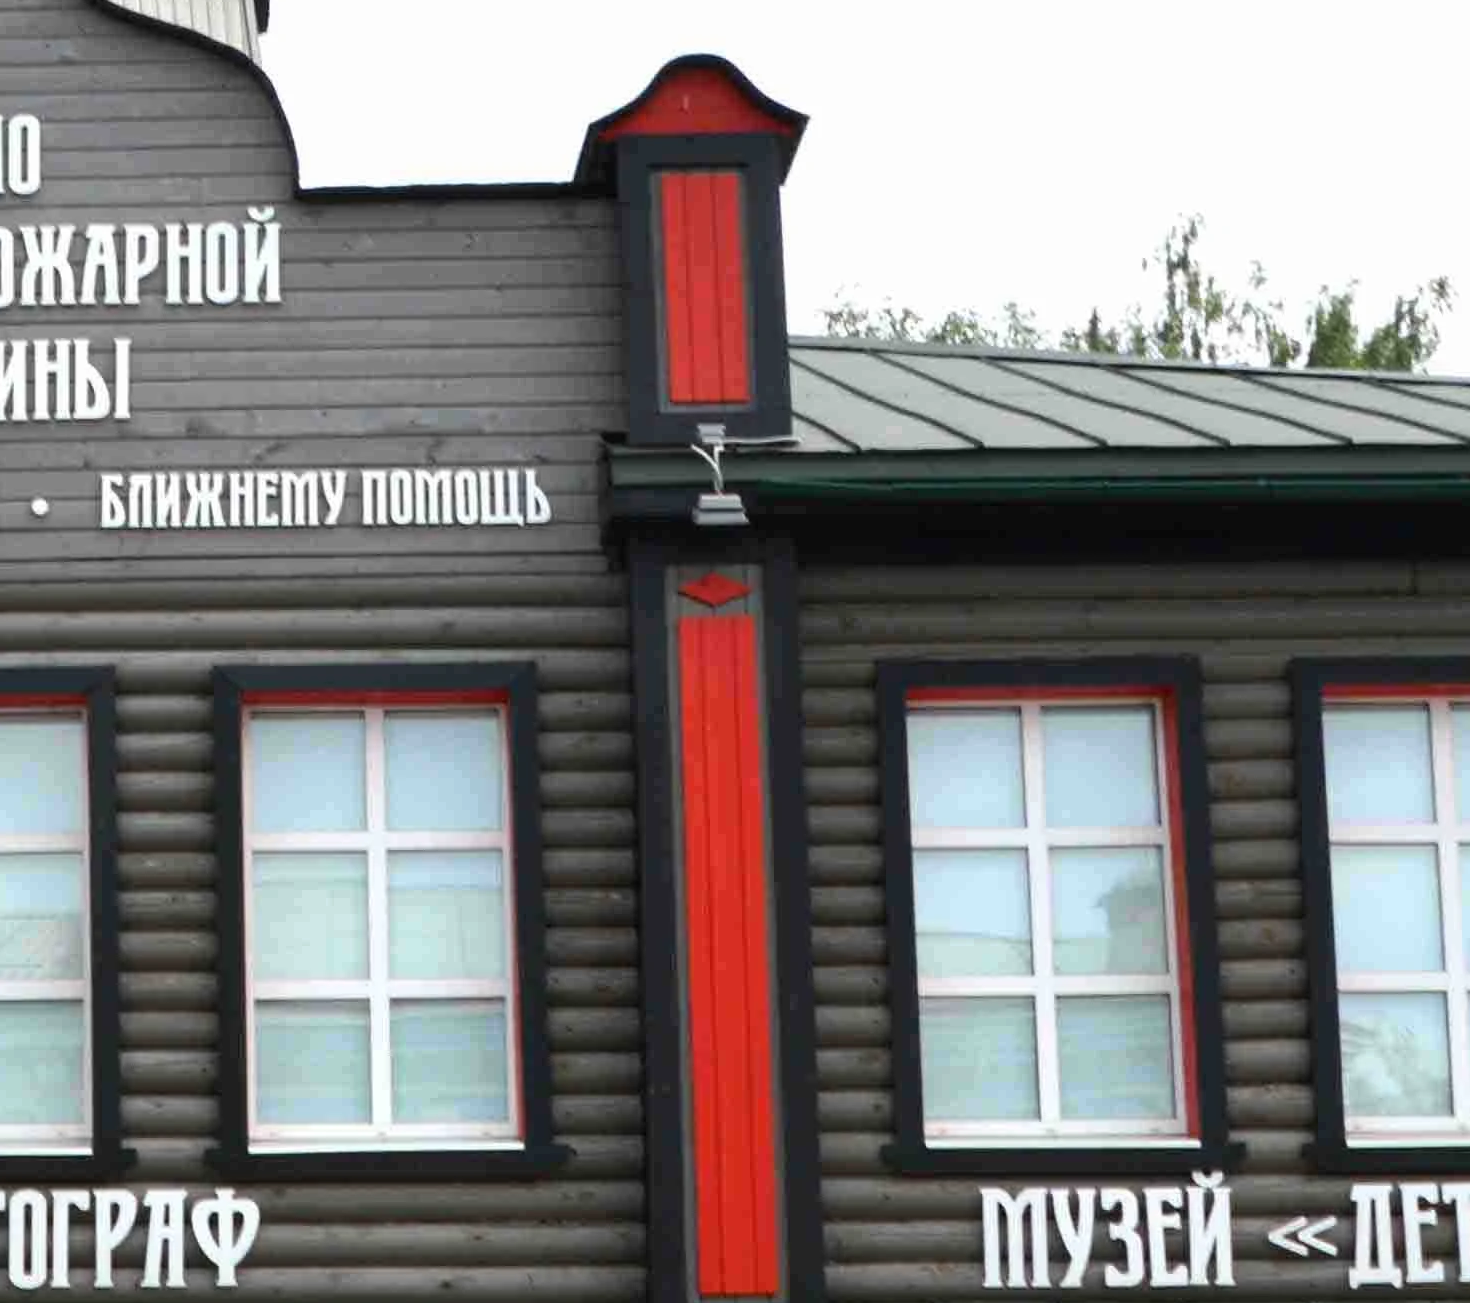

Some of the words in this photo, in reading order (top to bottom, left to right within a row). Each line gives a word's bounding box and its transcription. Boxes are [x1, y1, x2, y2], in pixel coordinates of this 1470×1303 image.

[99, 469, 347, 529] БЛИЖНЕМУ
[361, 468, 552, 527] ПОМОЩЬ
[979, 1170, 1235, 1289] МУЗЕЙ
